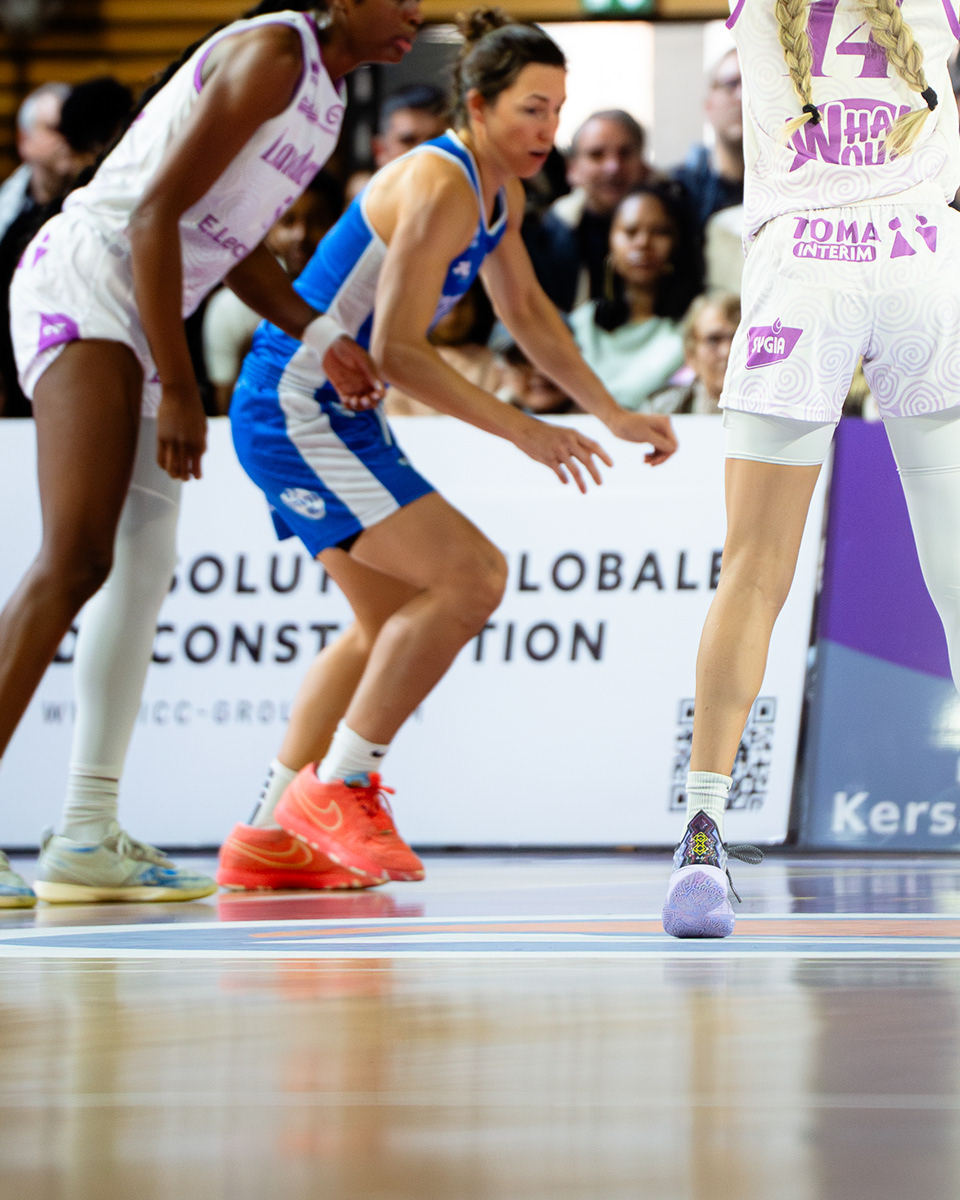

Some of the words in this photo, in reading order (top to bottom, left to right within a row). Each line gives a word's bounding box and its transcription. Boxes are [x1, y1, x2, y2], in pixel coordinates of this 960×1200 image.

[793, 216, 881, 243] TOMA
[797, 242, 873, 261] INTERIM
[752, 336, 785, 355] SYGIA
